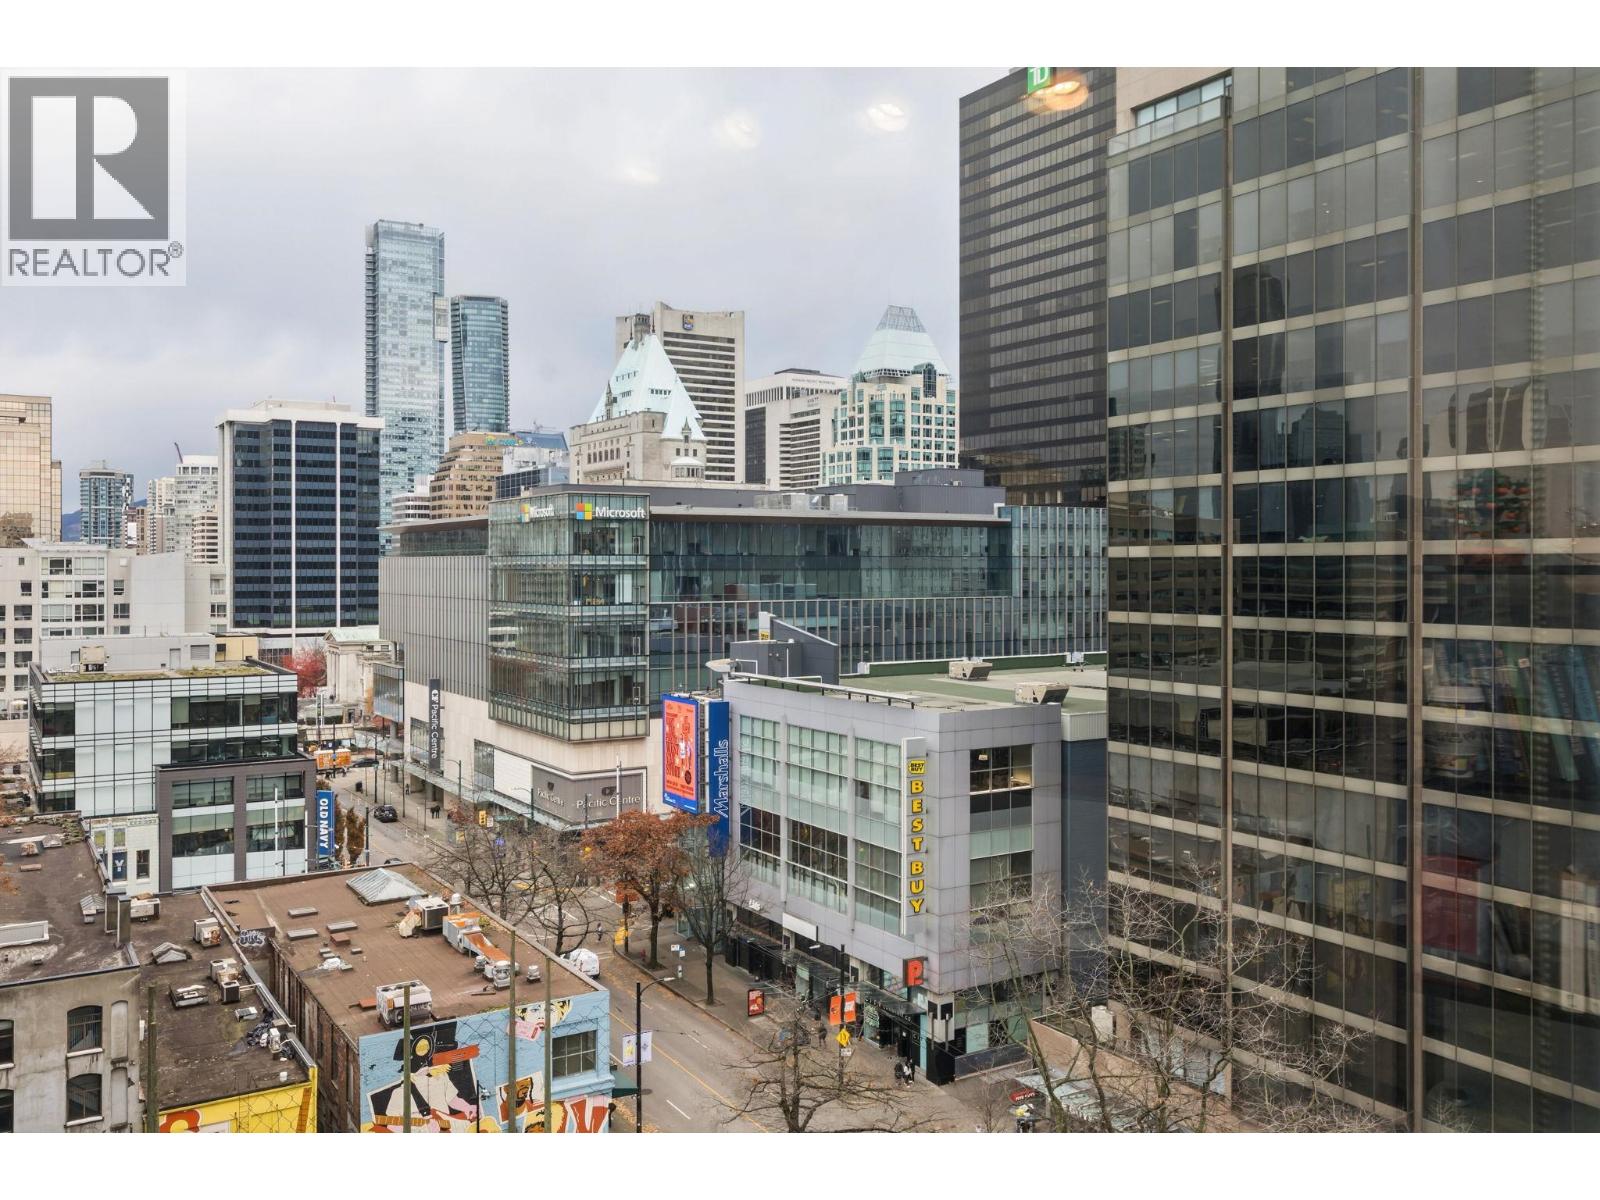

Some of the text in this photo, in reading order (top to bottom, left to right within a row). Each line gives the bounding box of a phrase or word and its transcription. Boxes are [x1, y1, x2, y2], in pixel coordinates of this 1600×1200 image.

[595, 506, 646, 519] Microsoft
[431, 704, 439, 730] Pacific
[431, 731, 439, 759] Centre
[713, 739, 729, 818] Marshalls
[319, 798, 329, 849] OLD NAVY
[909, 779, 925, 914] BEST BUY
